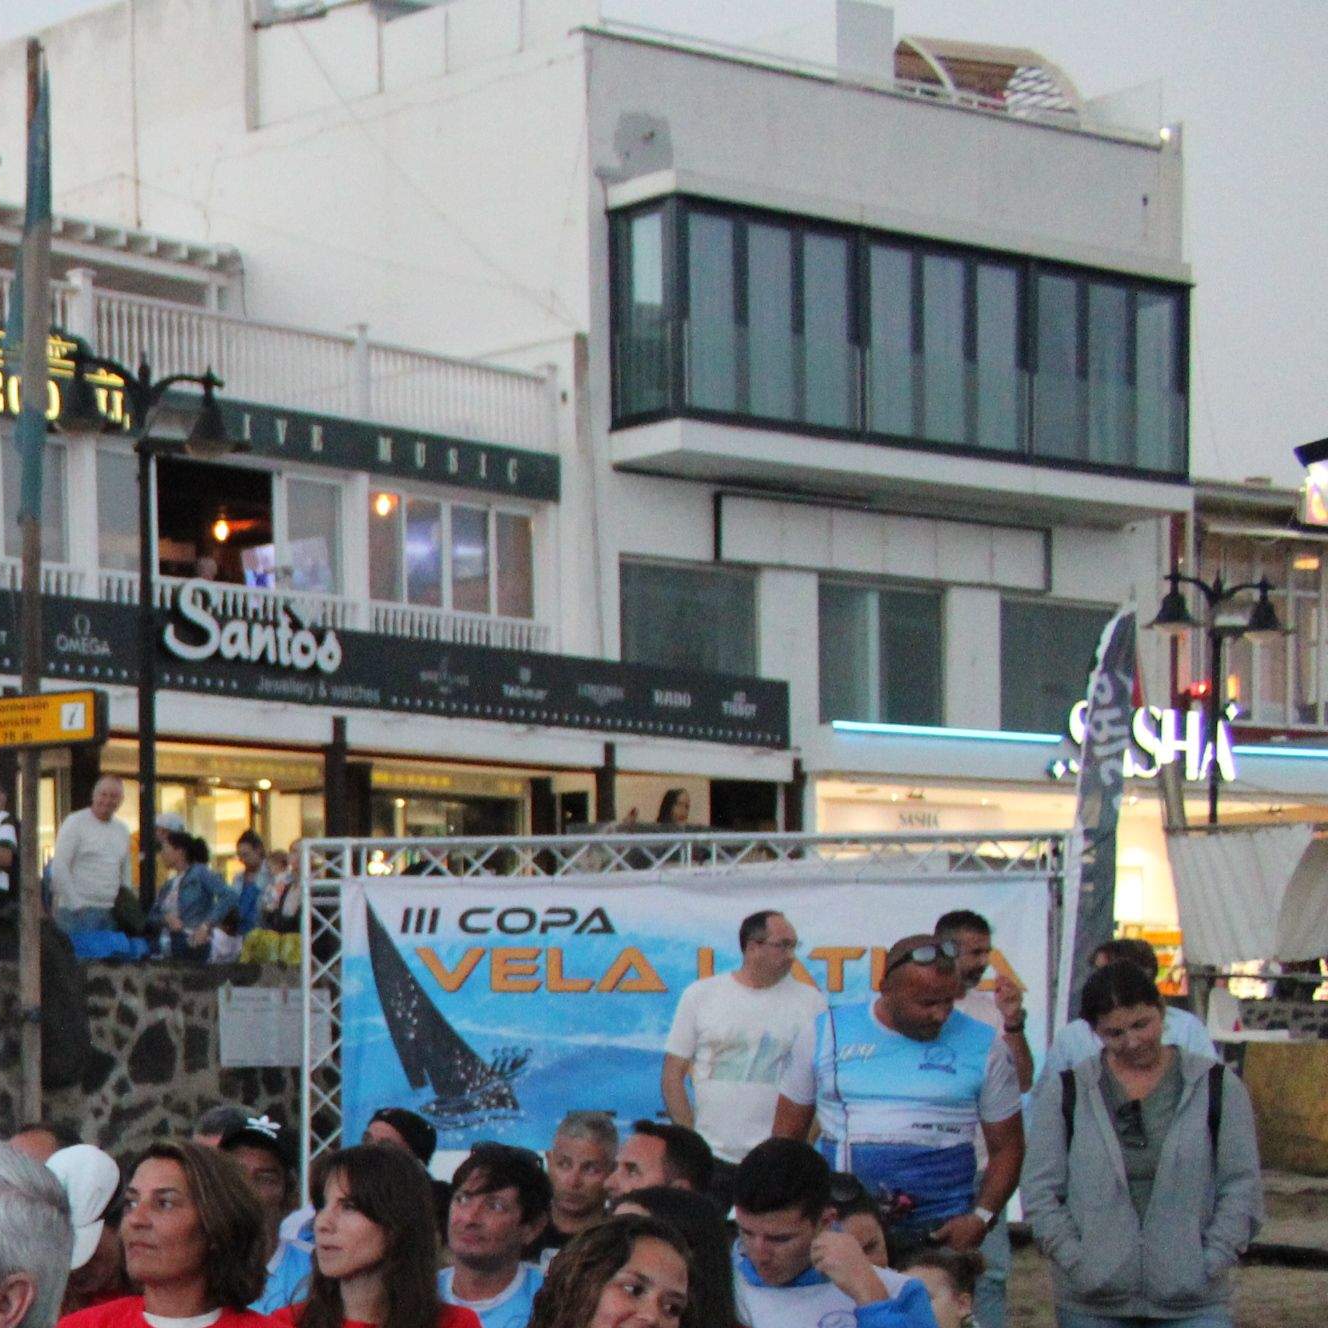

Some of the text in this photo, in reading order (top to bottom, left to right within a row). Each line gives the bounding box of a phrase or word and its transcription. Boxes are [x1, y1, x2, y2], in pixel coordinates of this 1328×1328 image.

[244, 412, 518, 485] IVE MUSIC
[56, 634, 111, 656] OMEGA
[164, 579, 343, 674] Santos
[401, 906, 616, 936] III COPA
[415, 946, 669, 993] VELA
